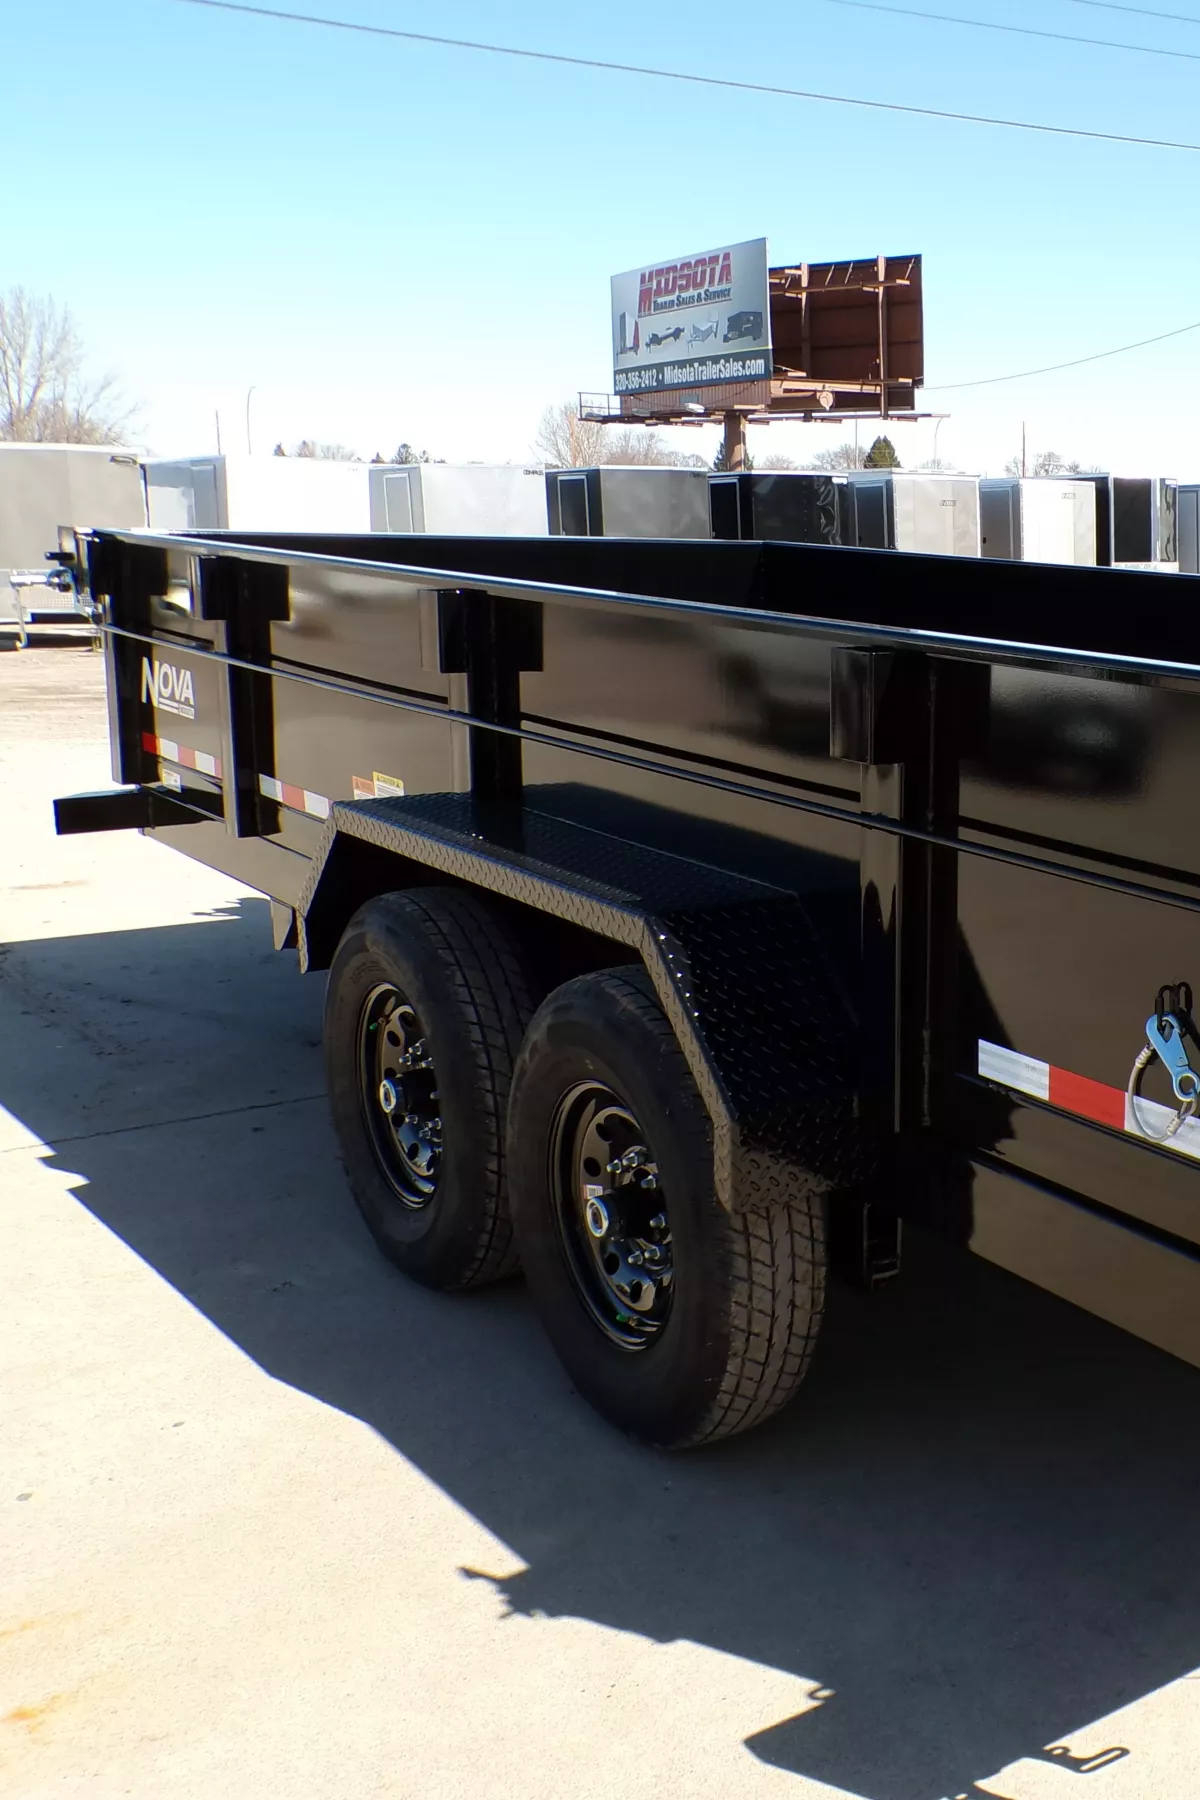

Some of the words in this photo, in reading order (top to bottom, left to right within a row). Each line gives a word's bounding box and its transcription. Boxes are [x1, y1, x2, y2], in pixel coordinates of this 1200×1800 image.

[638, 252, 732, 315] MIDSOTA
[697, 292, 703, 303] &
[615, 369, 657, 391] 320-356-2412
[664, 358, 765, 384] MidsotaTrailerSales.com
[142, 656, 195, 707] NOVA
